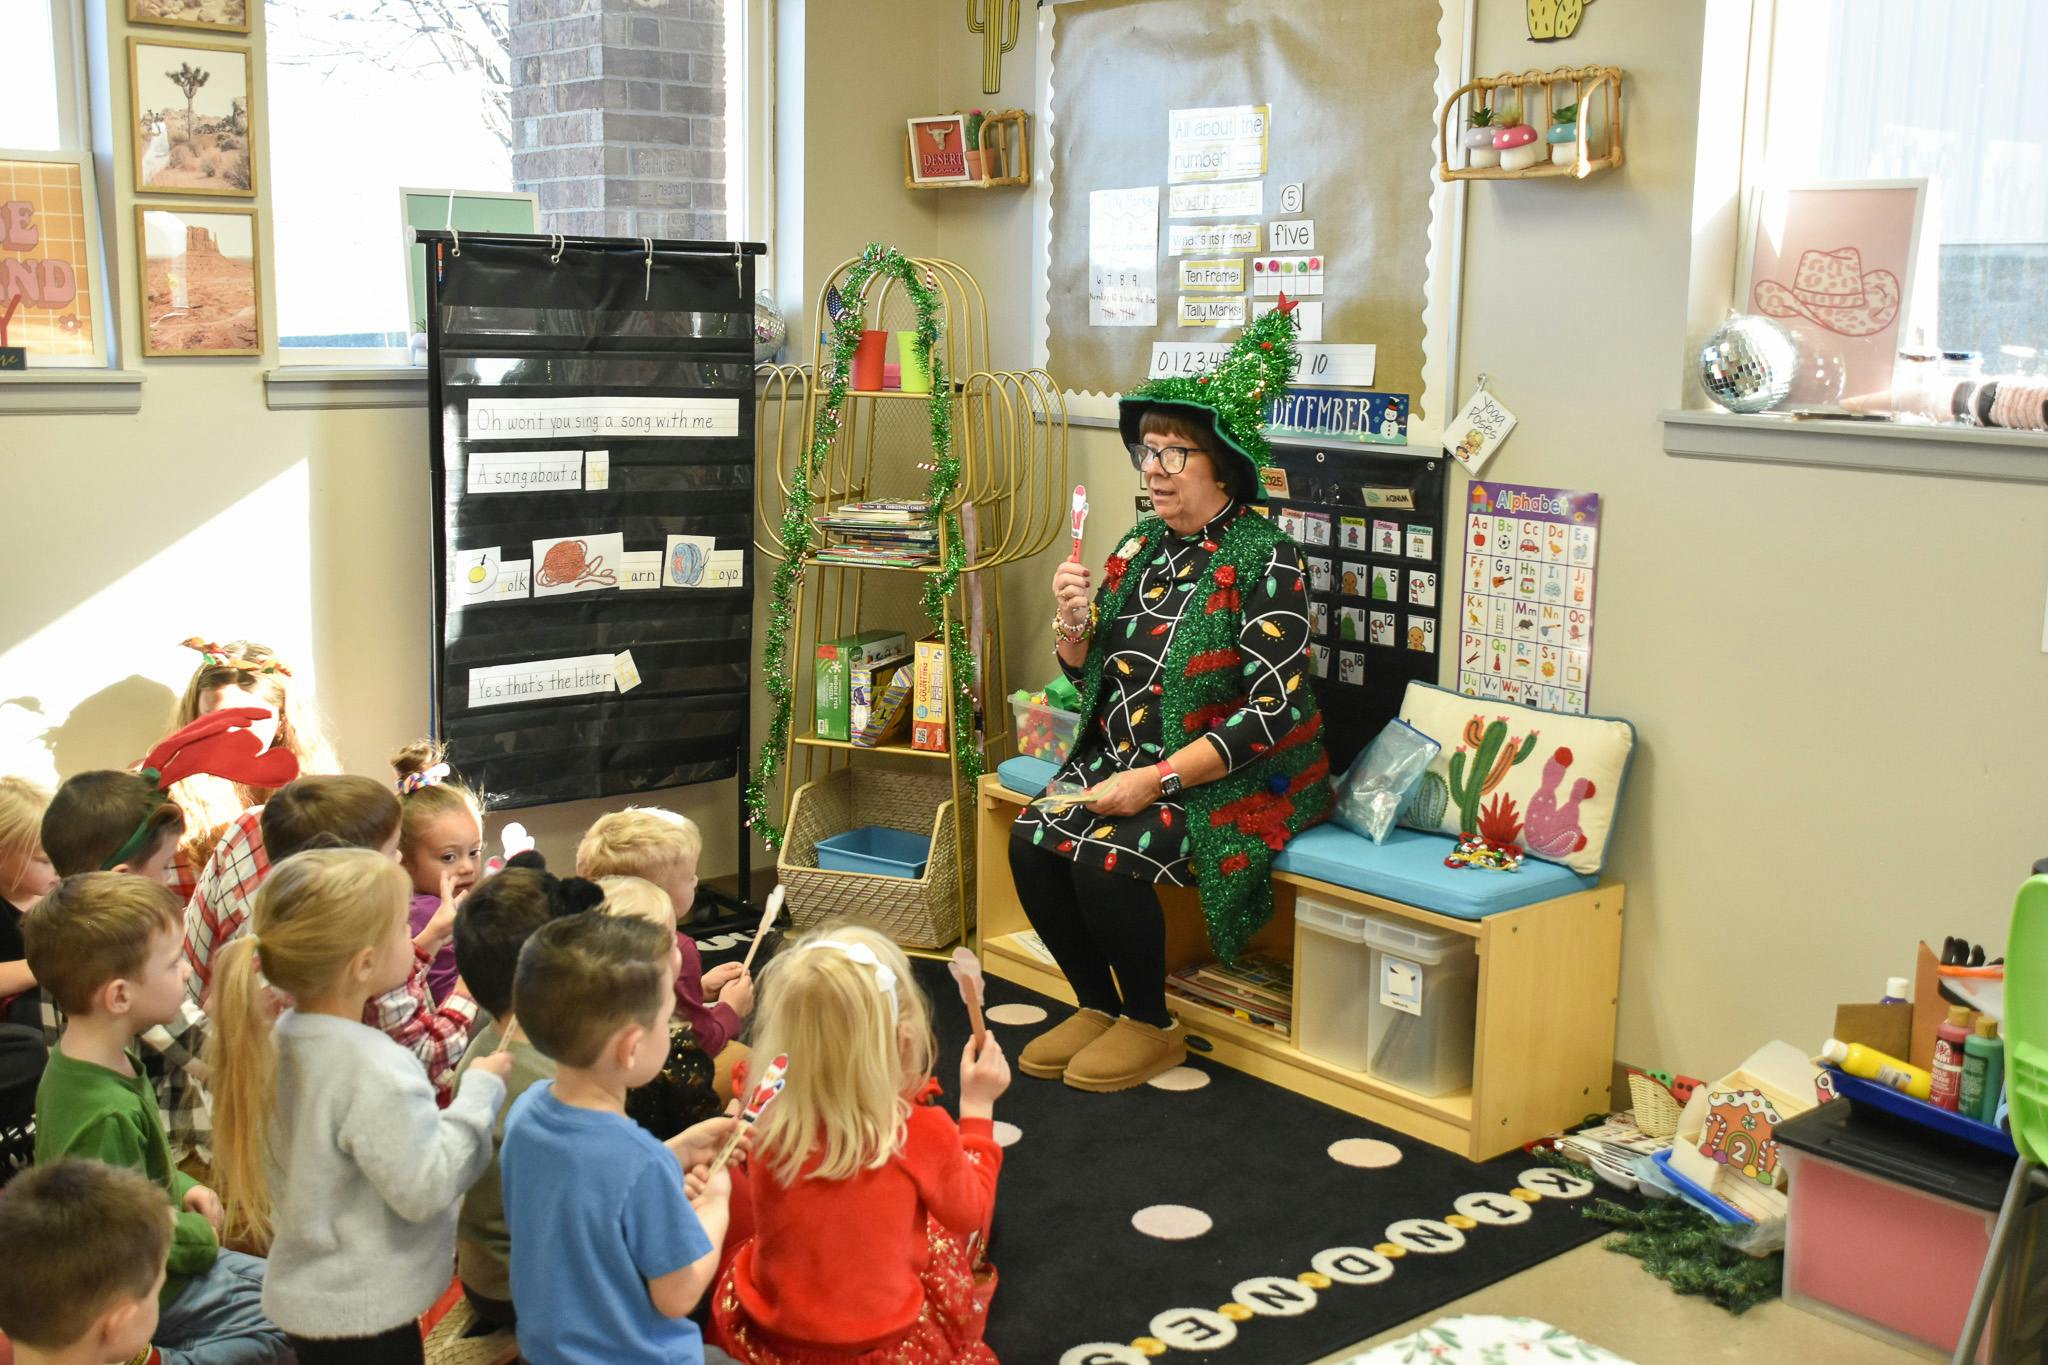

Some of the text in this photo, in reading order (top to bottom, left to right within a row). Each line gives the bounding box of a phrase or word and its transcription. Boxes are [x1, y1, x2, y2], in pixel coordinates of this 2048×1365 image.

[1195, 118, 1233, 137] about
[1242, 117, 1263, 133] the
[923, 152, 964, 165] DESERT
[1174, 149, 1227, 169] number
[1287, 190, 1296, 207] 5
[0, 201, 38, 251] E
[1275, 223, 1310, 247] five
[0, 258, 76, 309] ND
[1186, 270, 1239, 283] Ten Frame:
[1185, 304, 1241, 322] Tally Marks:
[1157, 351, 1169, 372] 0
[1182, 351, 1193, 373] 2
[1196, 352, 1207, 372] 3
[1209, 352, 1220, 369] 4
[1312, 354, 1328, 375] 10
[1272, 395, 1372, 436] DECEMBER
[1480, 396, 1507, 428] Yoga
[477, 408, 714, 435] Oh won't you sing a song with me
[1467, 406, 1498, 441] Poses
[479, 463, 488, 485] A
[495, 471, 528, 488] song
[530, 462, 566, 484] about
[571, 469, 578, 481] a
[1264, 475, 1284, 487] 025
[1140, 499, 1152, 507] THE
[1496, 489, 1569, 516] Alphabet
[1342, 517, 1363, 526] Thursday
[1408, 525, 1432, 534] Saturday
[1323, 561, 1330, 574] 3
[1357, 566, 1364, 578] 4
[1389, 570, 1397, 583] 5
[1427, 574, 1435, 587] 6
[1317, 604, 1327, 616] 10
[1384, 613, 1394, 627] 12
[1423, 620, 1433, 633] 13
[1320, 647, 1329, 659] 17
[1354, 653, 1364, 666] 18
[478, 679, 502, 699] Yes
[507, 674, 544, 696] that's
[549, 669, 571, 690] the
[575, 666, 611, 688] letter
[1731, 1141, 1748, 1163] 2
